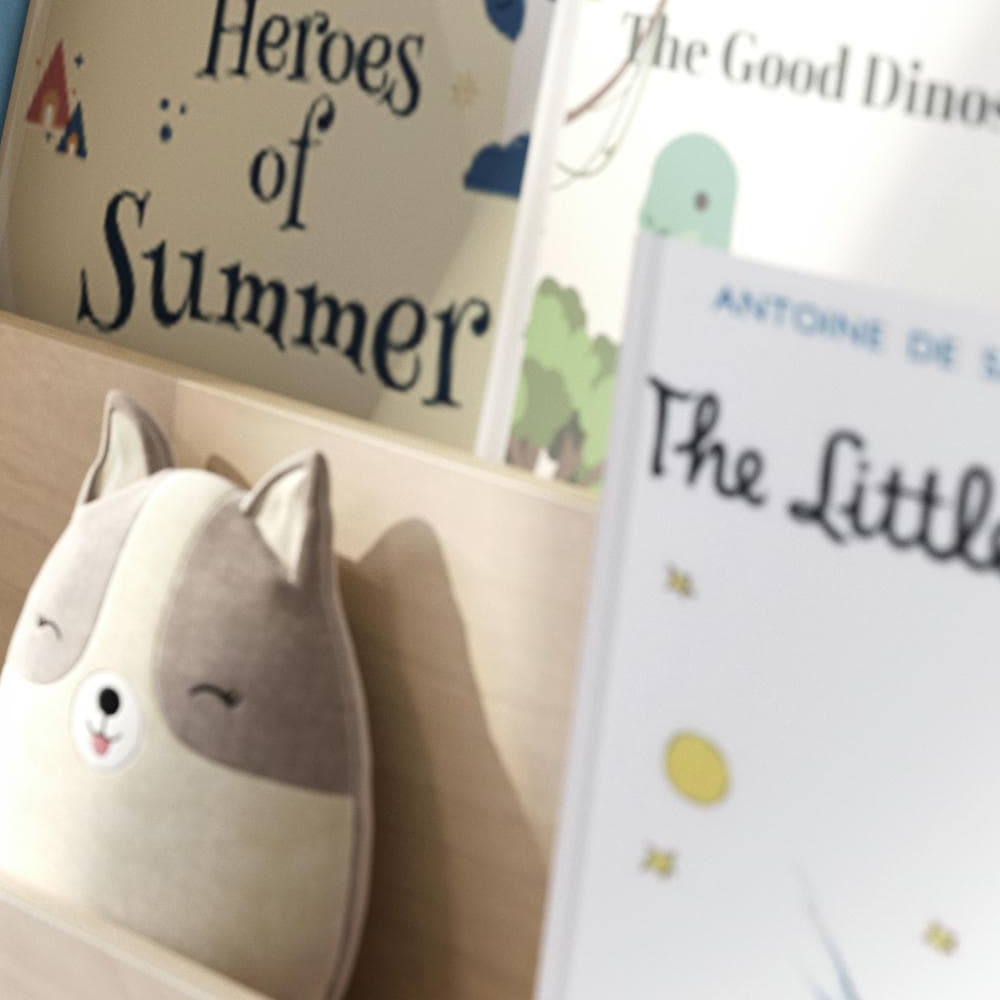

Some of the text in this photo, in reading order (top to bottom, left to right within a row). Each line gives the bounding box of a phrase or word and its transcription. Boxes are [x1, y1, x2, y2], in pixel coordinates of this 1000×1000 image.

[623, 10, 710, 76] The
[722, 30, 851, 102] Good
[248, 94, 336, 231] of
[76, 190, 491, 408] Summer
[714, 285, 885, 355] ANTOINE
[904, 328, 956, 371] DE
[646, 375, 767, 508] The
